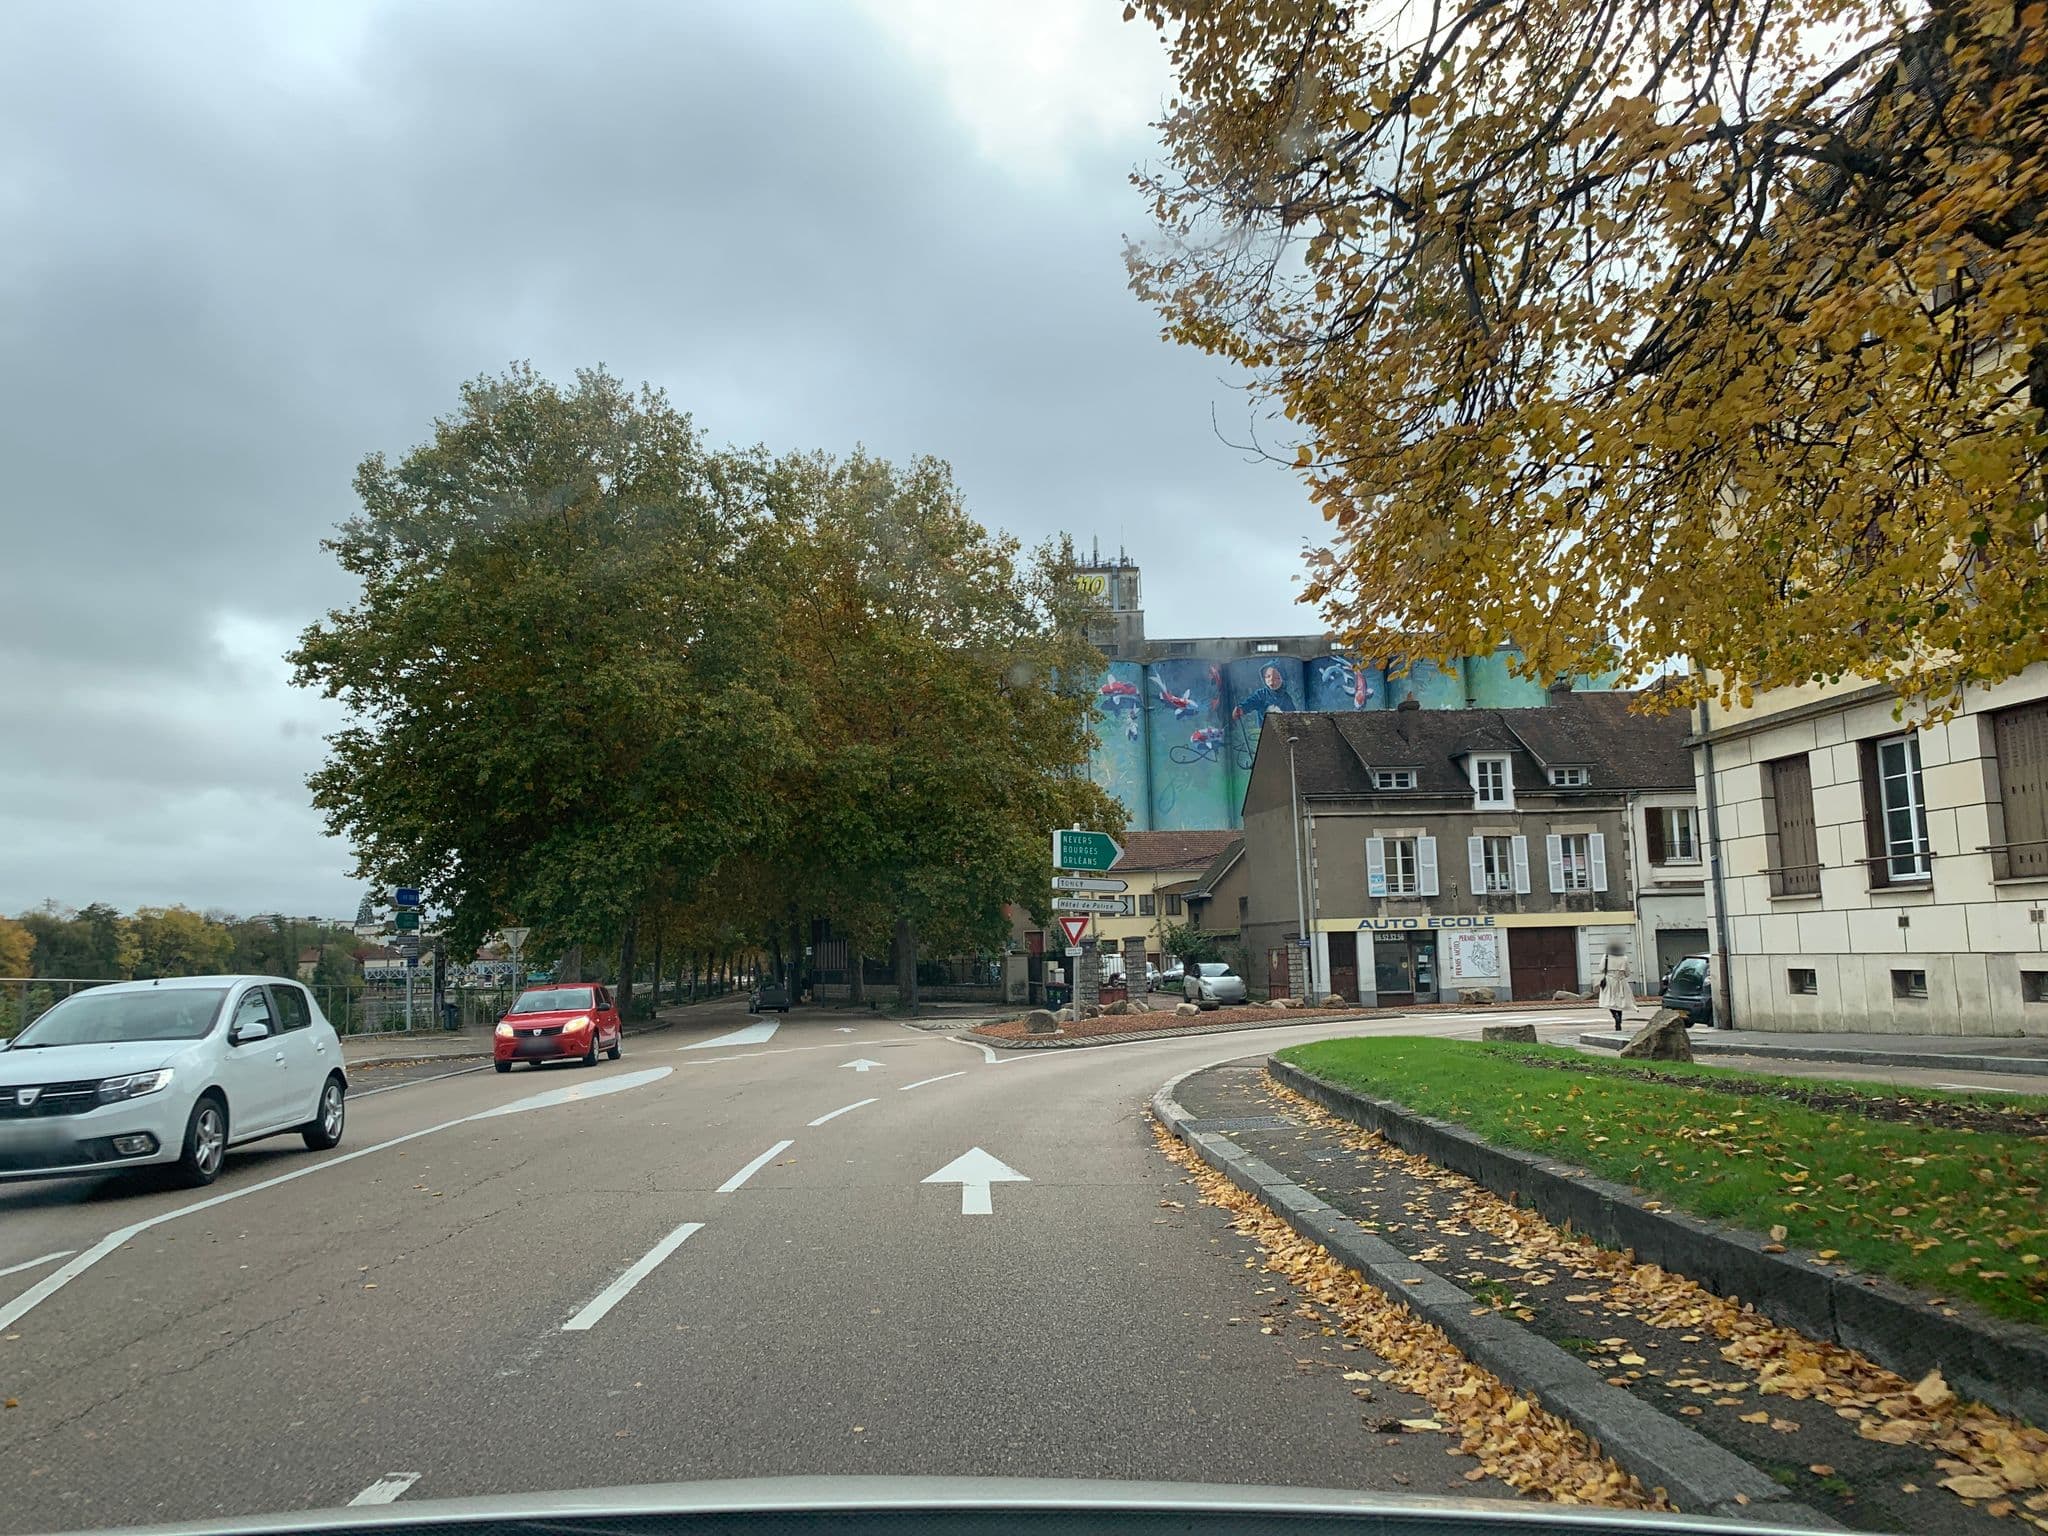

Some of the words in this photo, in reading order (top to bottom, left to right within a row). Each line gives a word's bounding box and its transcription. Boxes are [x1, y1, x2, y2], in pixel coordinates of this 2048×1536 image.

[1063, 835, 1092, 845] NEVERS
[1063, 845, 1098, 855] BOURGES
[1063, 856, 1097, 866] ORLÉANS
[1357, 919, 1418, 929] AUTO
[1427, 916, 1496, 928] ECOLE
